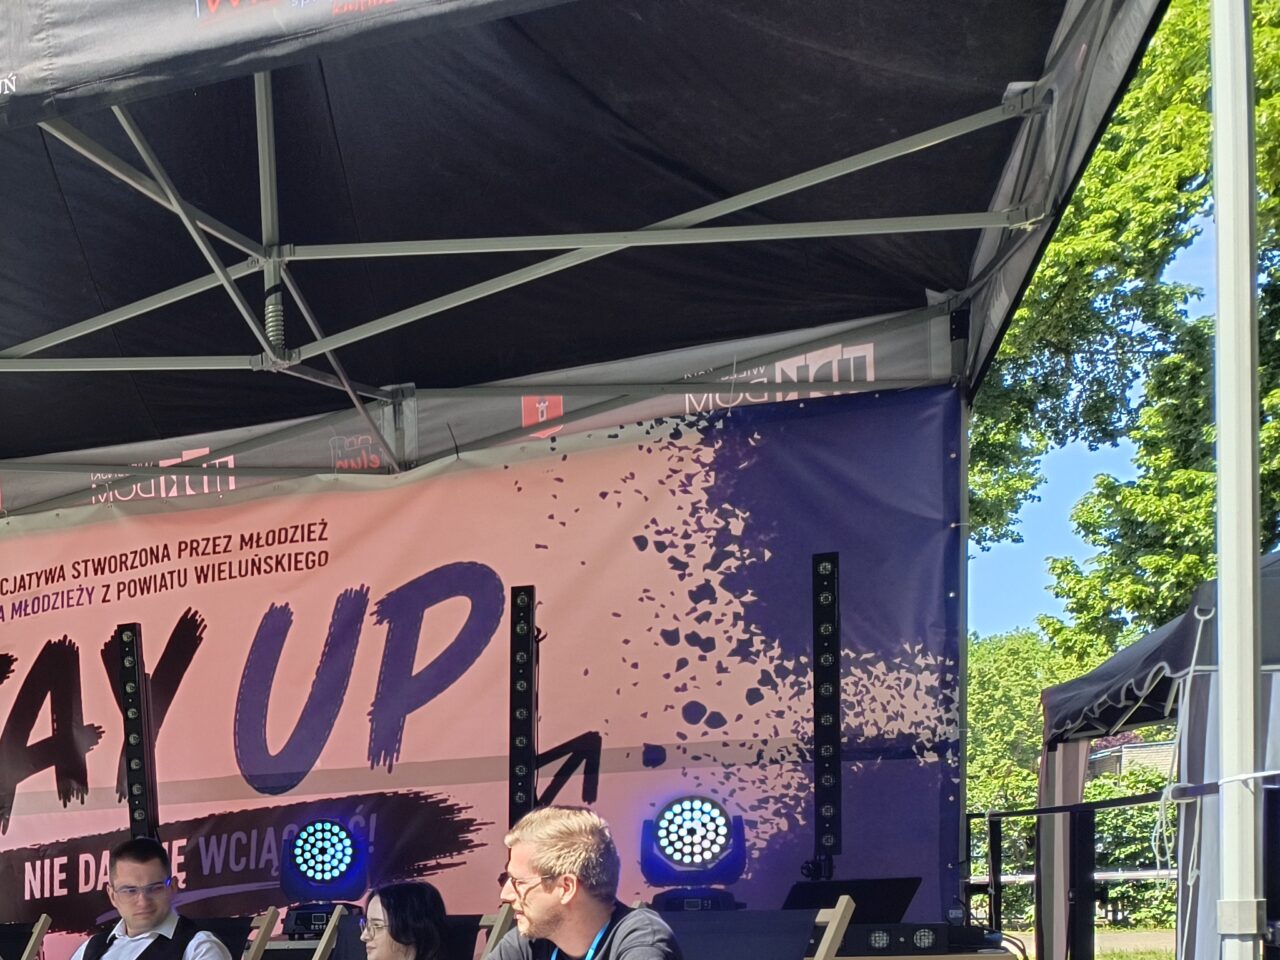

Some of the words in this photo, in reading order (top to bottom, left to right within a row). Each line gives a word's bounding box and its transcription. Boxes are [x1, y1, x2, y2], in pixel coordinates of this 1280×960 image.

[71, 543, 171, 579] STWORZONA
[178, 534, 232, 559] PRZEZ
[239, 518, 328, 551] MŁODZIEŻ
[10, 584, 95, 620] MŁODZIEŻY
[101, 584, 111, 603] Z
[116, 568, 188, 601] POWIATU
[194, 550, 329, 584] WIELUŃSKIEGO
[233, 560, 506, 795] UP
[24, 853, 68, 900] NIE
[78, 849, 111, 894] DA
